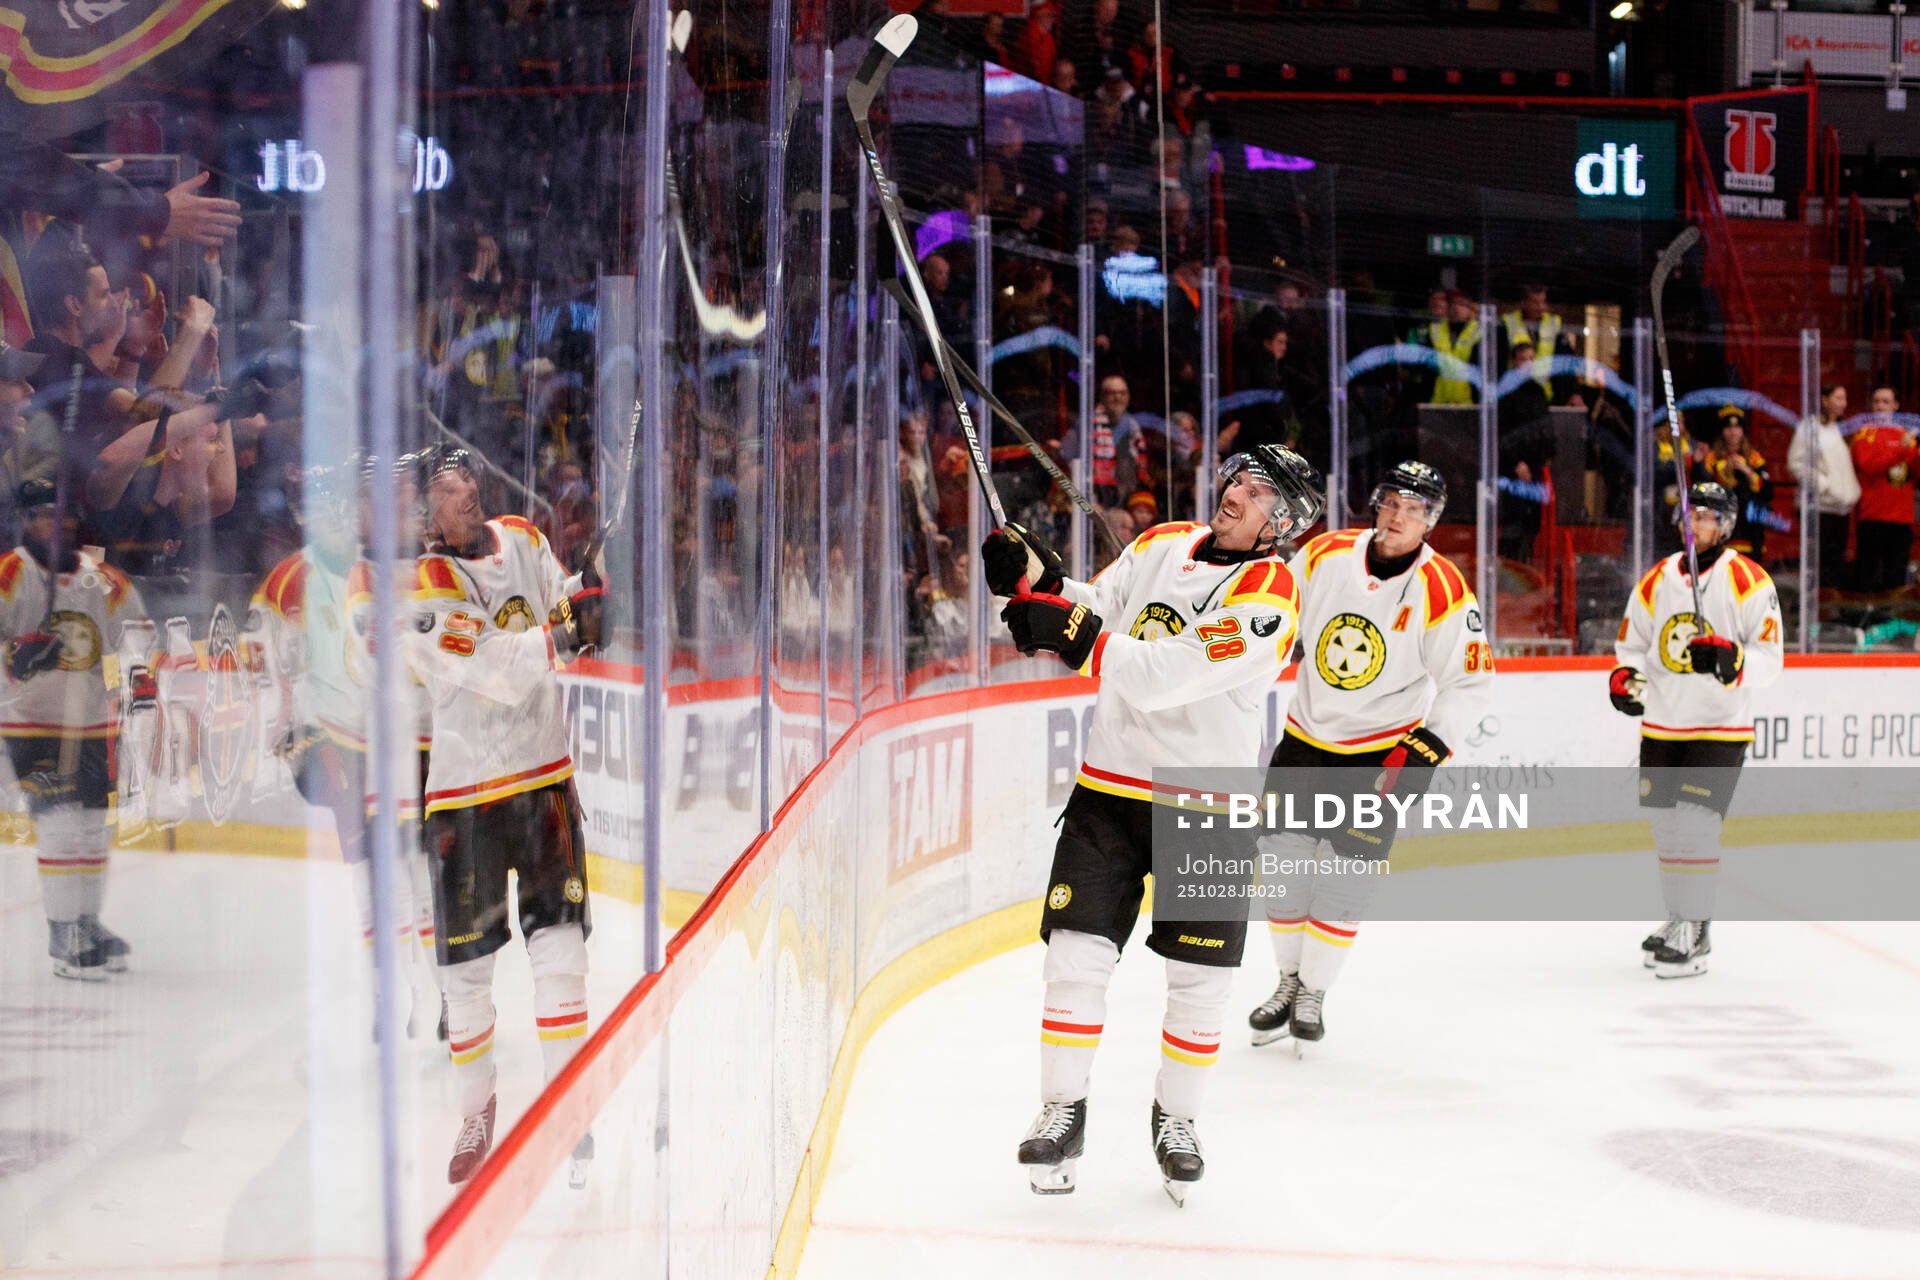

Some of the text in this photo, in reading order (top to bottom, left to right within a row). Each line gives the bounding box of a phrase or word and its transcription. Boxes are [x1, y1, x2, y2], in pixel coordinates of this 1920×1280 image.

[1575, 142, 1646, 196] dt
[960, 414, 988, 474] BAUER
[1150, 606, 1172, 622] 1912
[1345, 615, 1367, 629] 1912
[1392, 606, 1412, 631] A
[1195, 616, 1247, 662] 28
[1803, 715, 1829, 760] EL
[1842, 714, 1859, 758] &
[1178, 934, 1225, 949] BAUER
